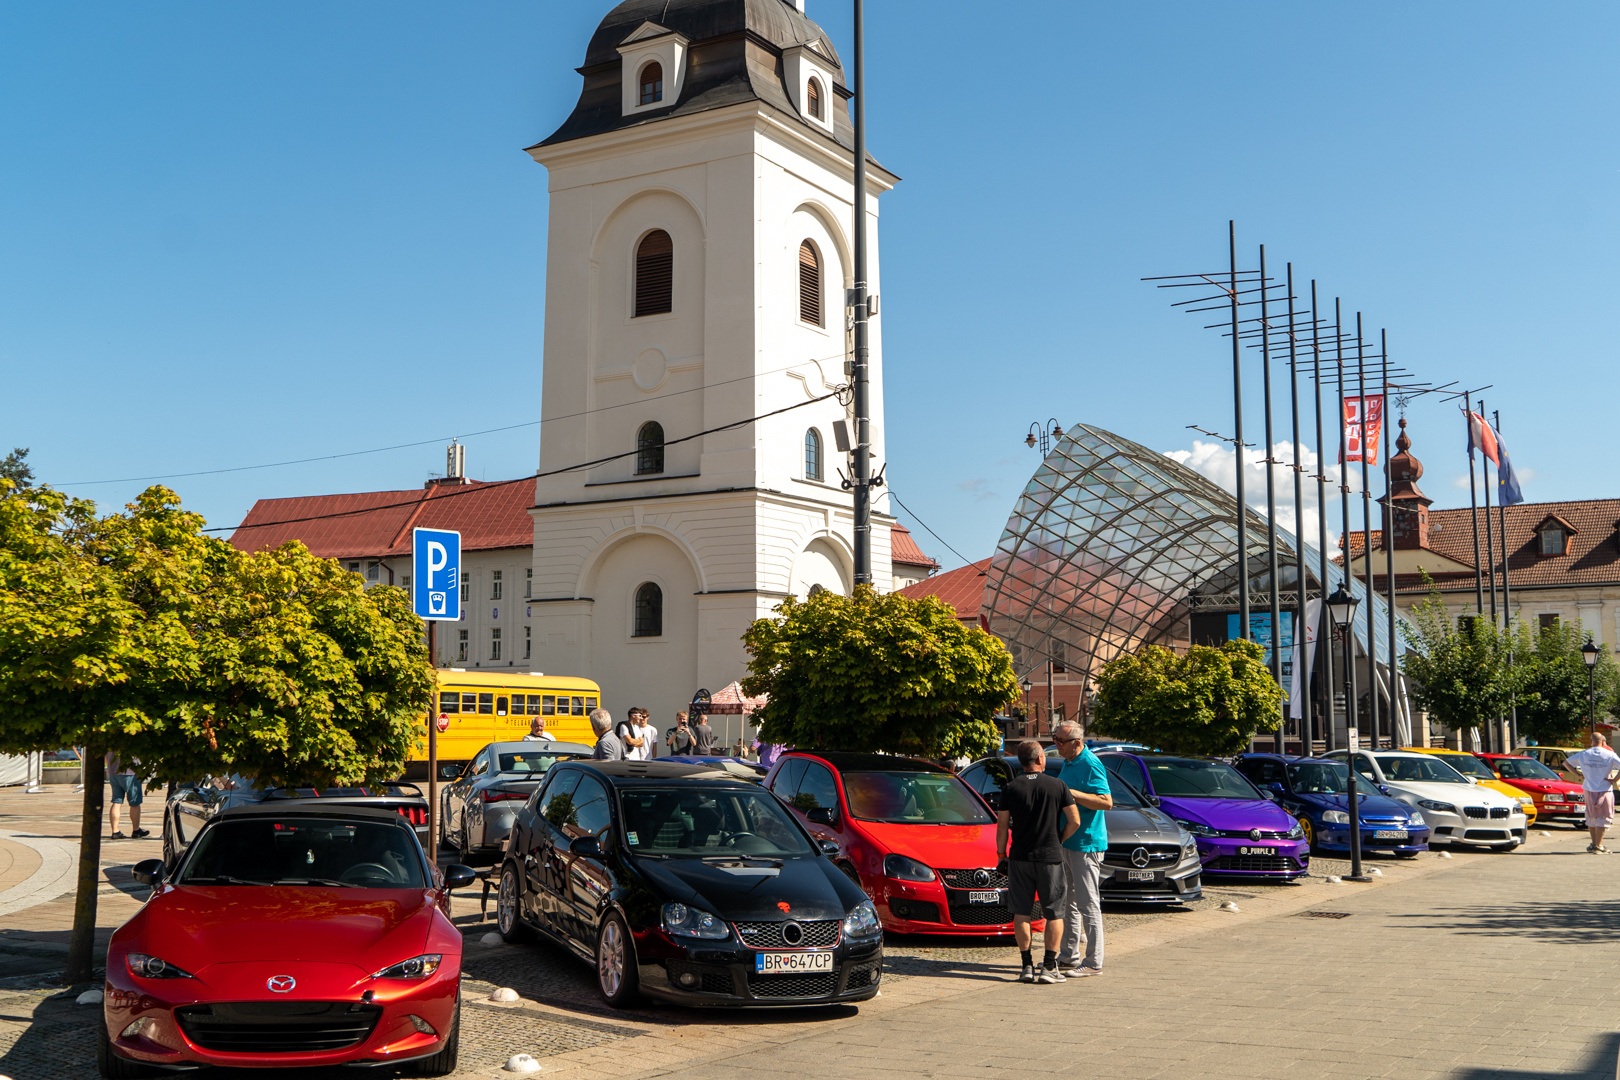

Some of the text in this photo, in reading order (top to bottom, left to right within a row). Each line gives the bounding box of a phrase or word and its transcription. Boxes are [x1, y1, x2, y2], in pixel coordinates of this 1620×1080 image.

[427, 541, 448, 589] P
[438, 718, 448, 726] STOP
[510, 719, 531, 727] TELGAR
[970, 892, 999, 900] BROTHERS
